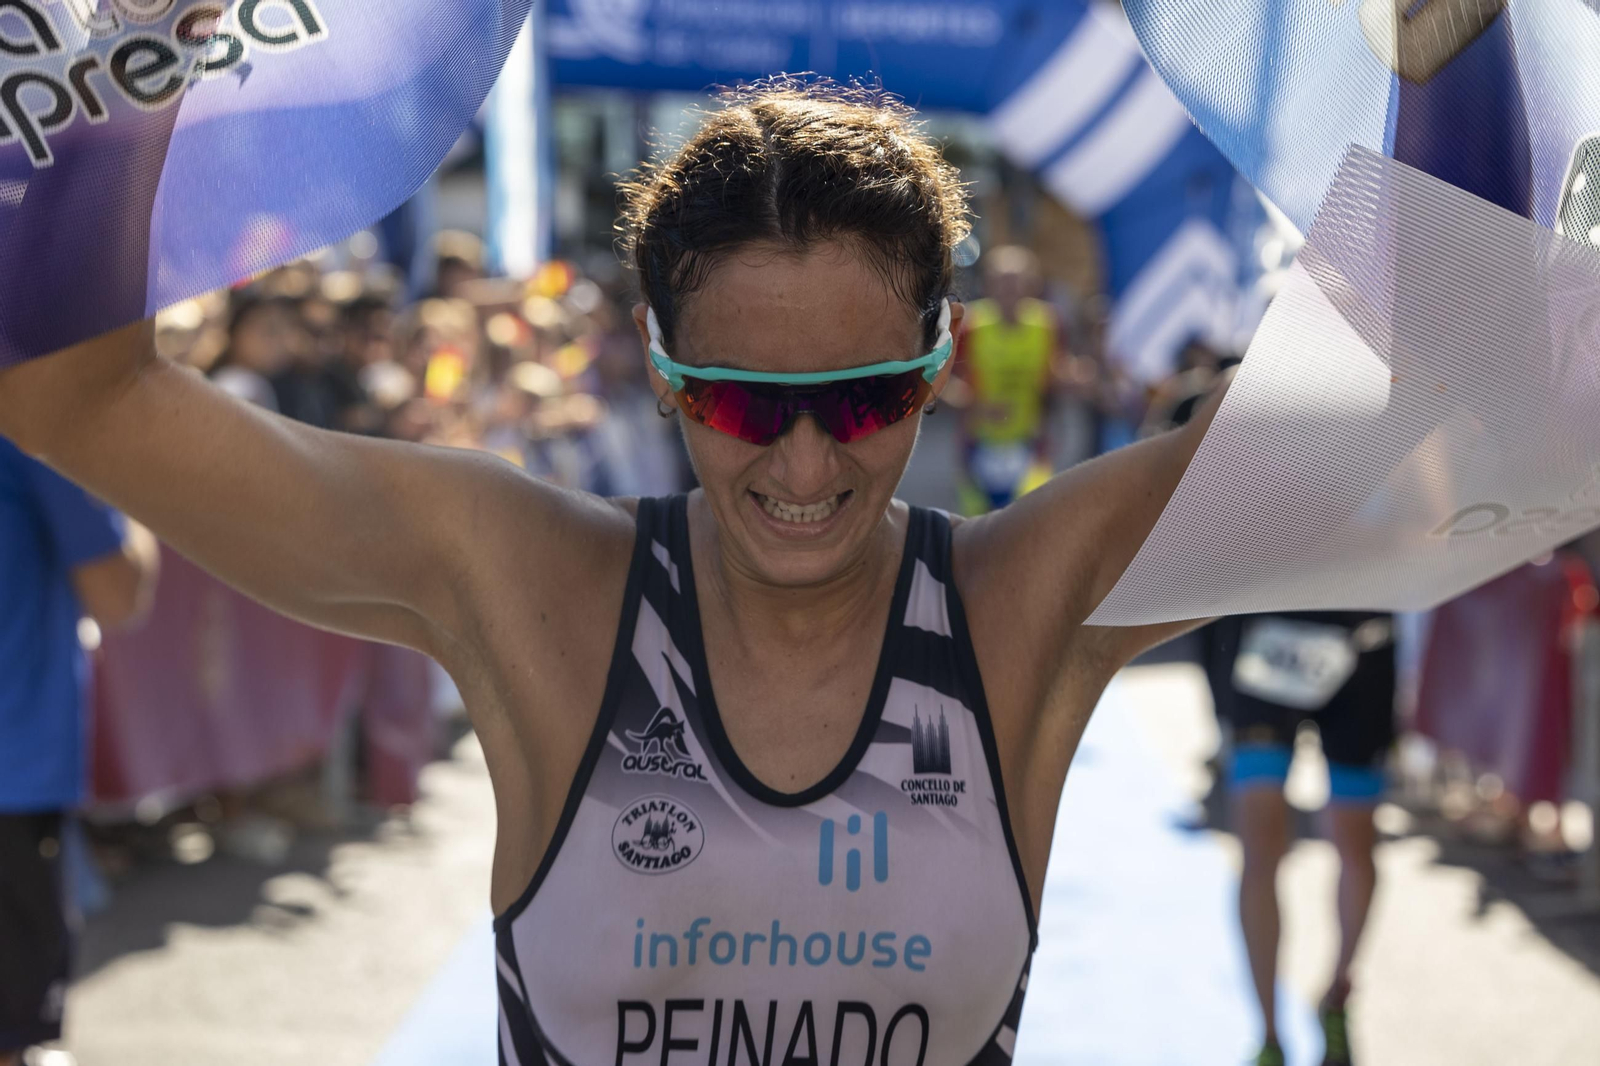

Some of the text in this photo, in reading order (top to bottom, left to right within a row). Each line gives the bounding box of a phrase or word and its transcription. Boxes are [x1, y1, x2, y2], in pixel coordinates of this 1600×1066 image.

[622, 754, 708, 781] austral
[901, 778, 966, 793] CONCELLO DE
[911, 792, 958, 807] SANTIAGO
[622, 800, 697, 834] TRIATLON
[618, 840, 692, 870] SANTIAGO
[633, 917, 932, 972] inforhouse
